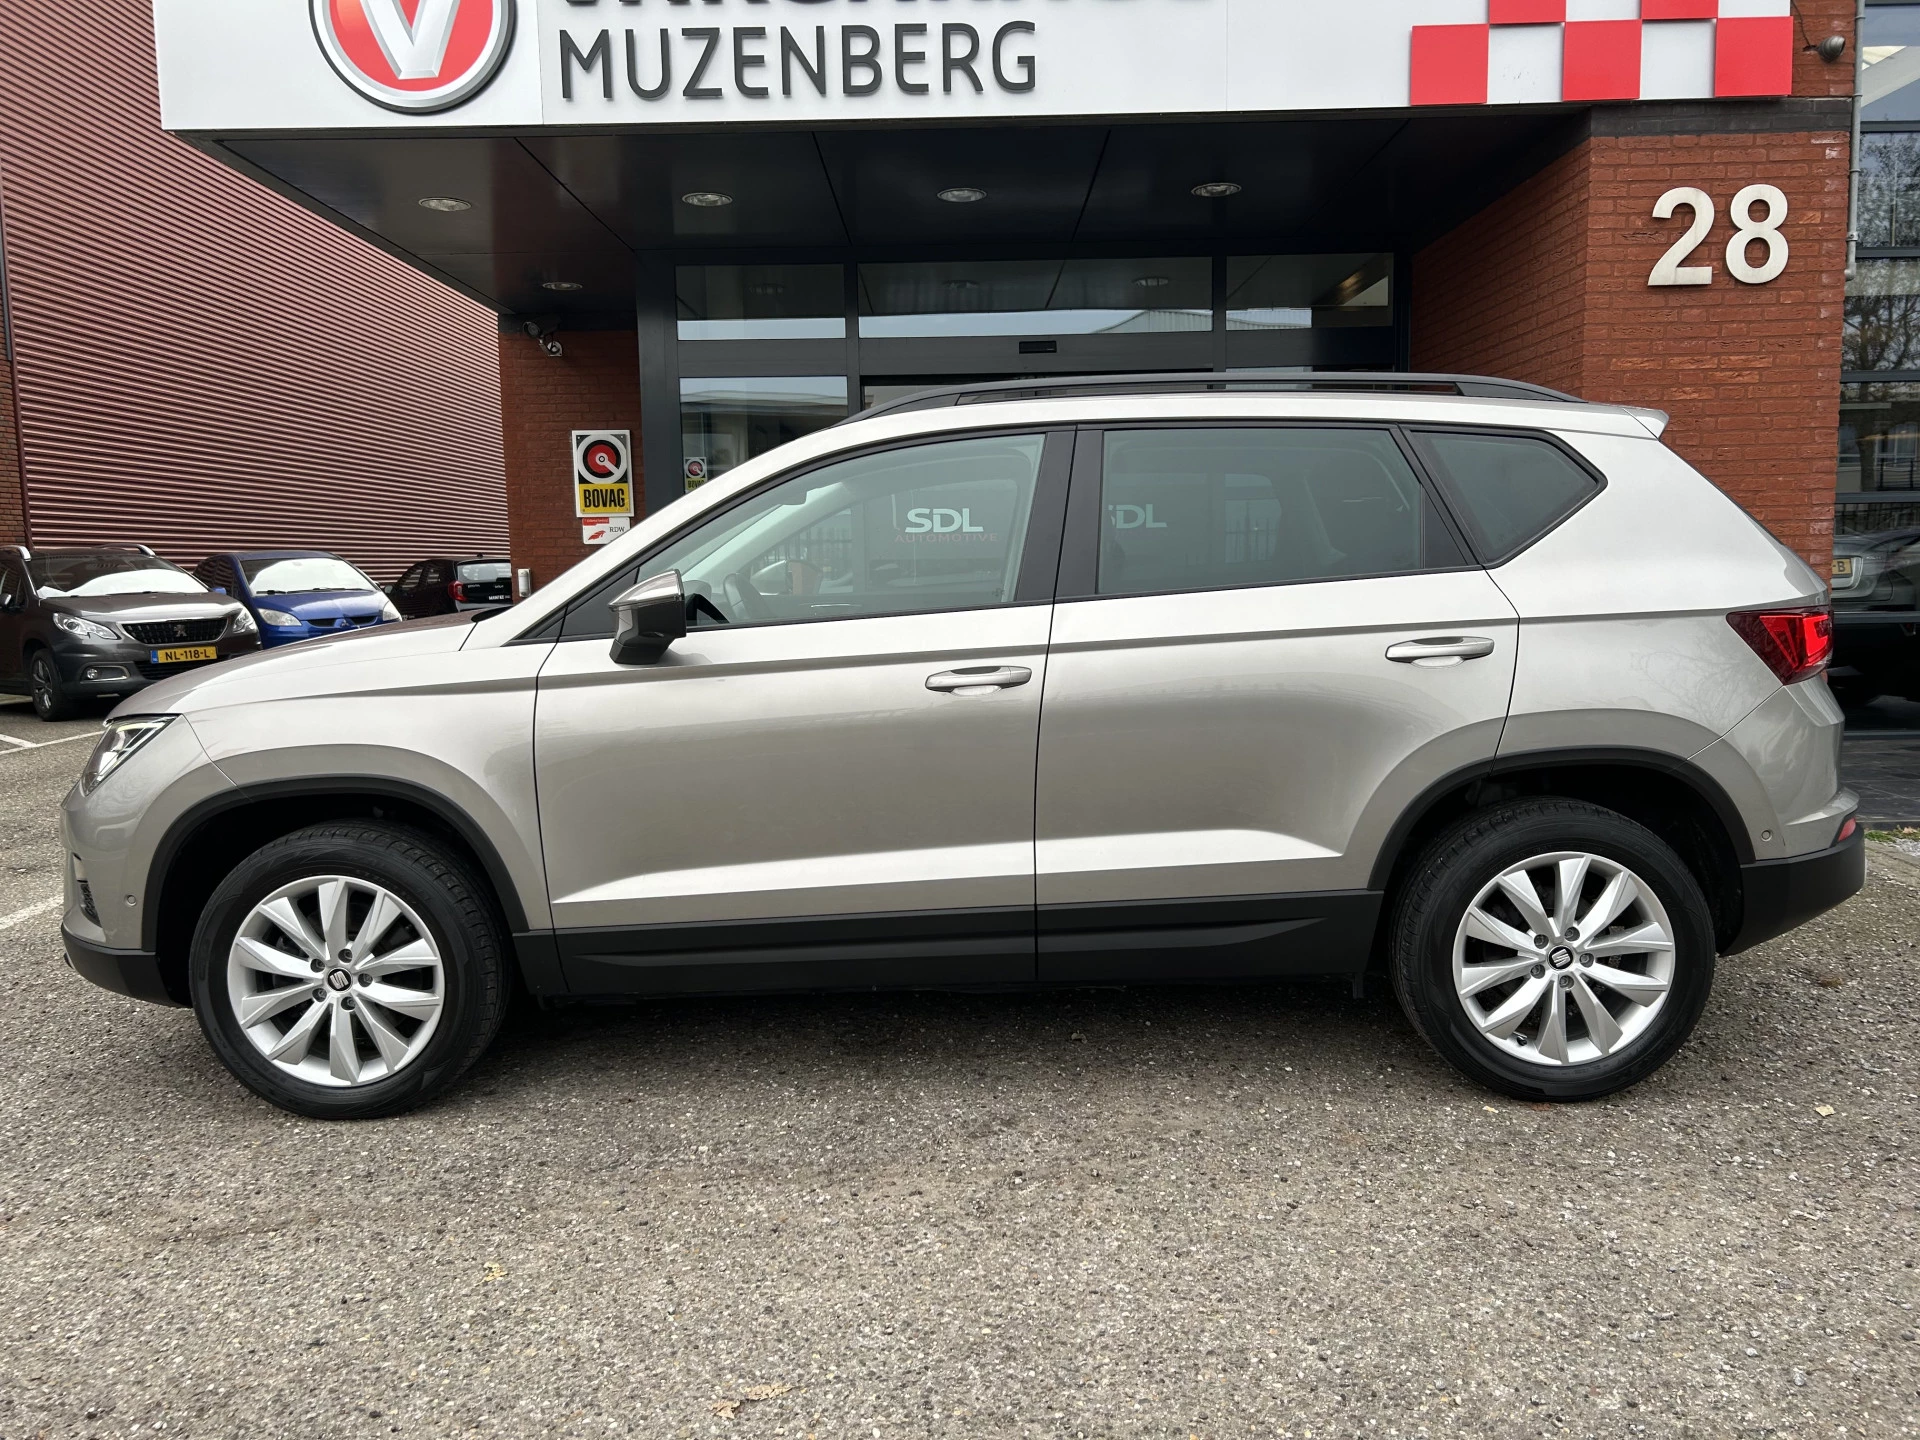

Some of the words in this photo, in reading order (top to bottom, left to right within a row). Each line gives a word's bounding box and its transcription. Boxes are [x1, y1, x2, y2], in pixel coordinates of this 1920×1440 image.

[560, 21, 1036, 99] MUZENBERG
[1648, 184, 1789, 287] 28
[583, 488, 625, 508] BOVAG
[905, 508, 984, 533] SDL
[1108, 503, 1168, 529] DL
[894, 532, 998, 544] AUTOMOTIVE
[165, 649, 210, 661] NL-118-L
